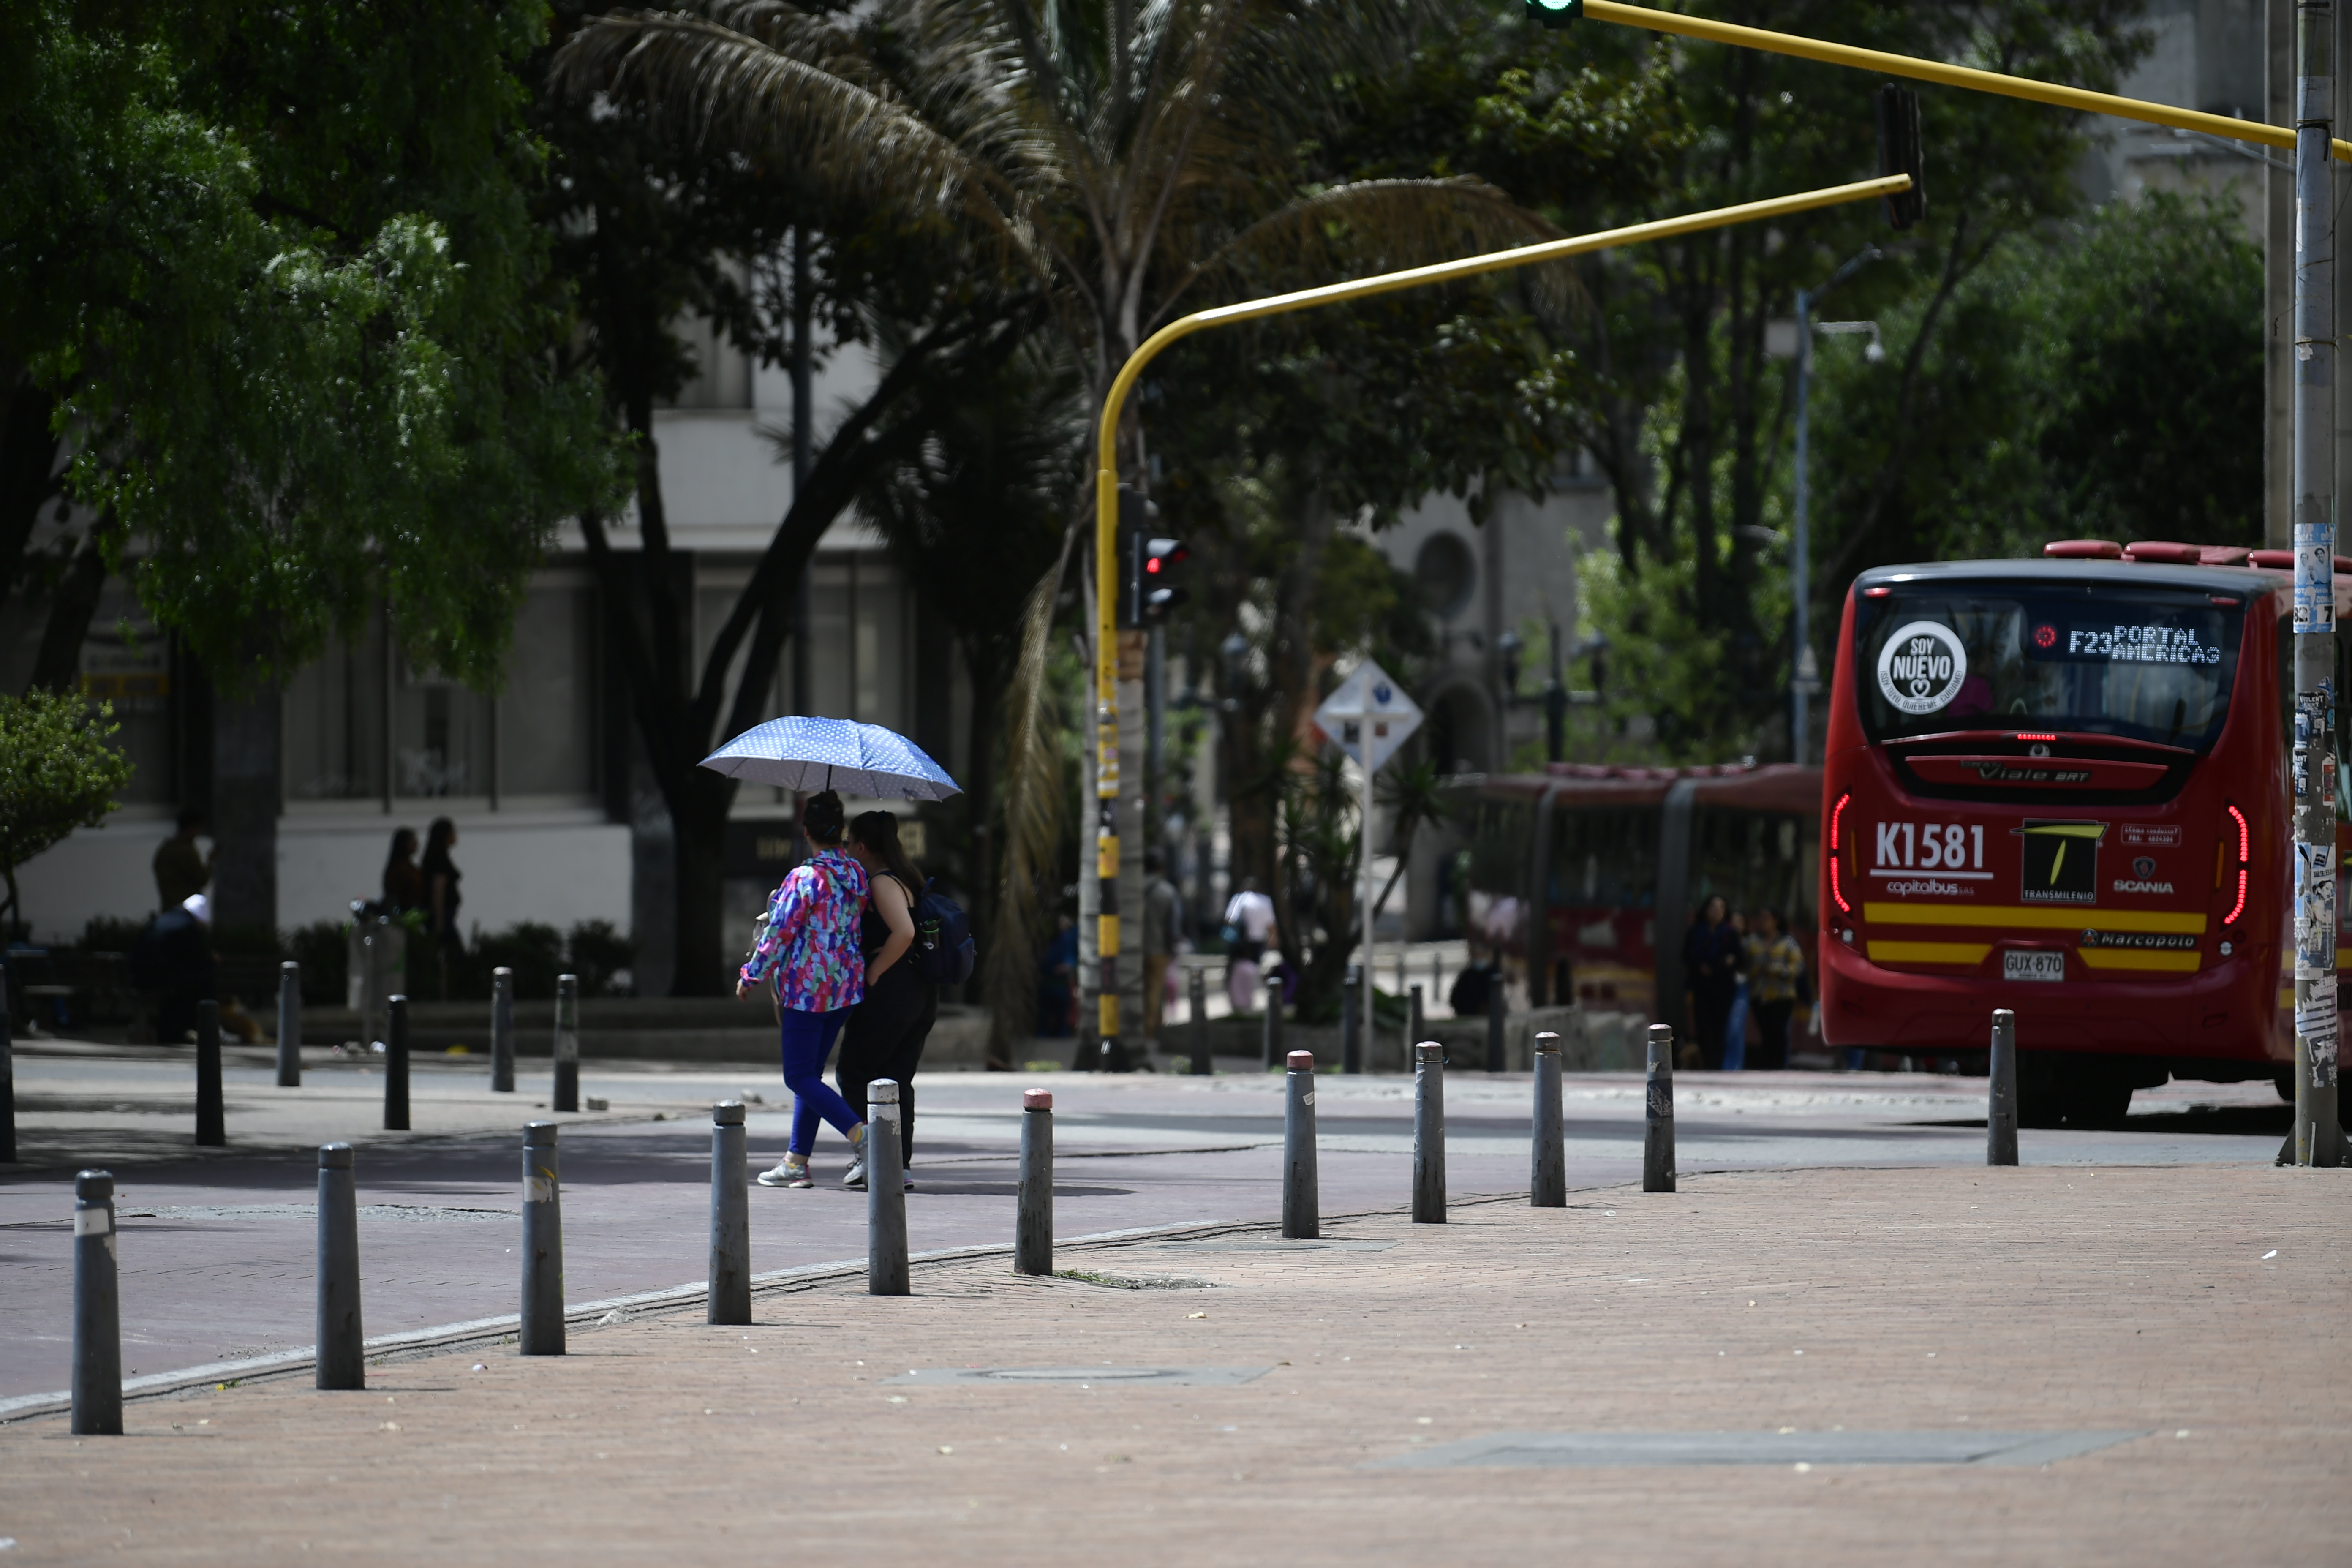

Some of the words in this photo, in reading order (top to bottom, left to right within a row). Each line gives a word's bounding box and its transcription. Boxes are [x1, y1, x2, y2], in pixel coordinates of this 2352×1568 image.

[2069, 630, 2112, 653] F23
[2113, 625, 2199, 645] PORTAL
[1910, 637, 1935, 656] SOY
[1893, 655, 1951, 681] NUEVO
[1979, 767, 2047, 780] Viale
[2055, 771, 2089, 781] BRT
[1876, 822, 1983, 869] K1581
[1887, 879, 1958, 897] capitalbus
[2023, 889, 2094, 901] TRANSMILENIO
[2113, 879, 2175, 894] SCANIA
[2101, 932, 2195, 948] Marcopolo
